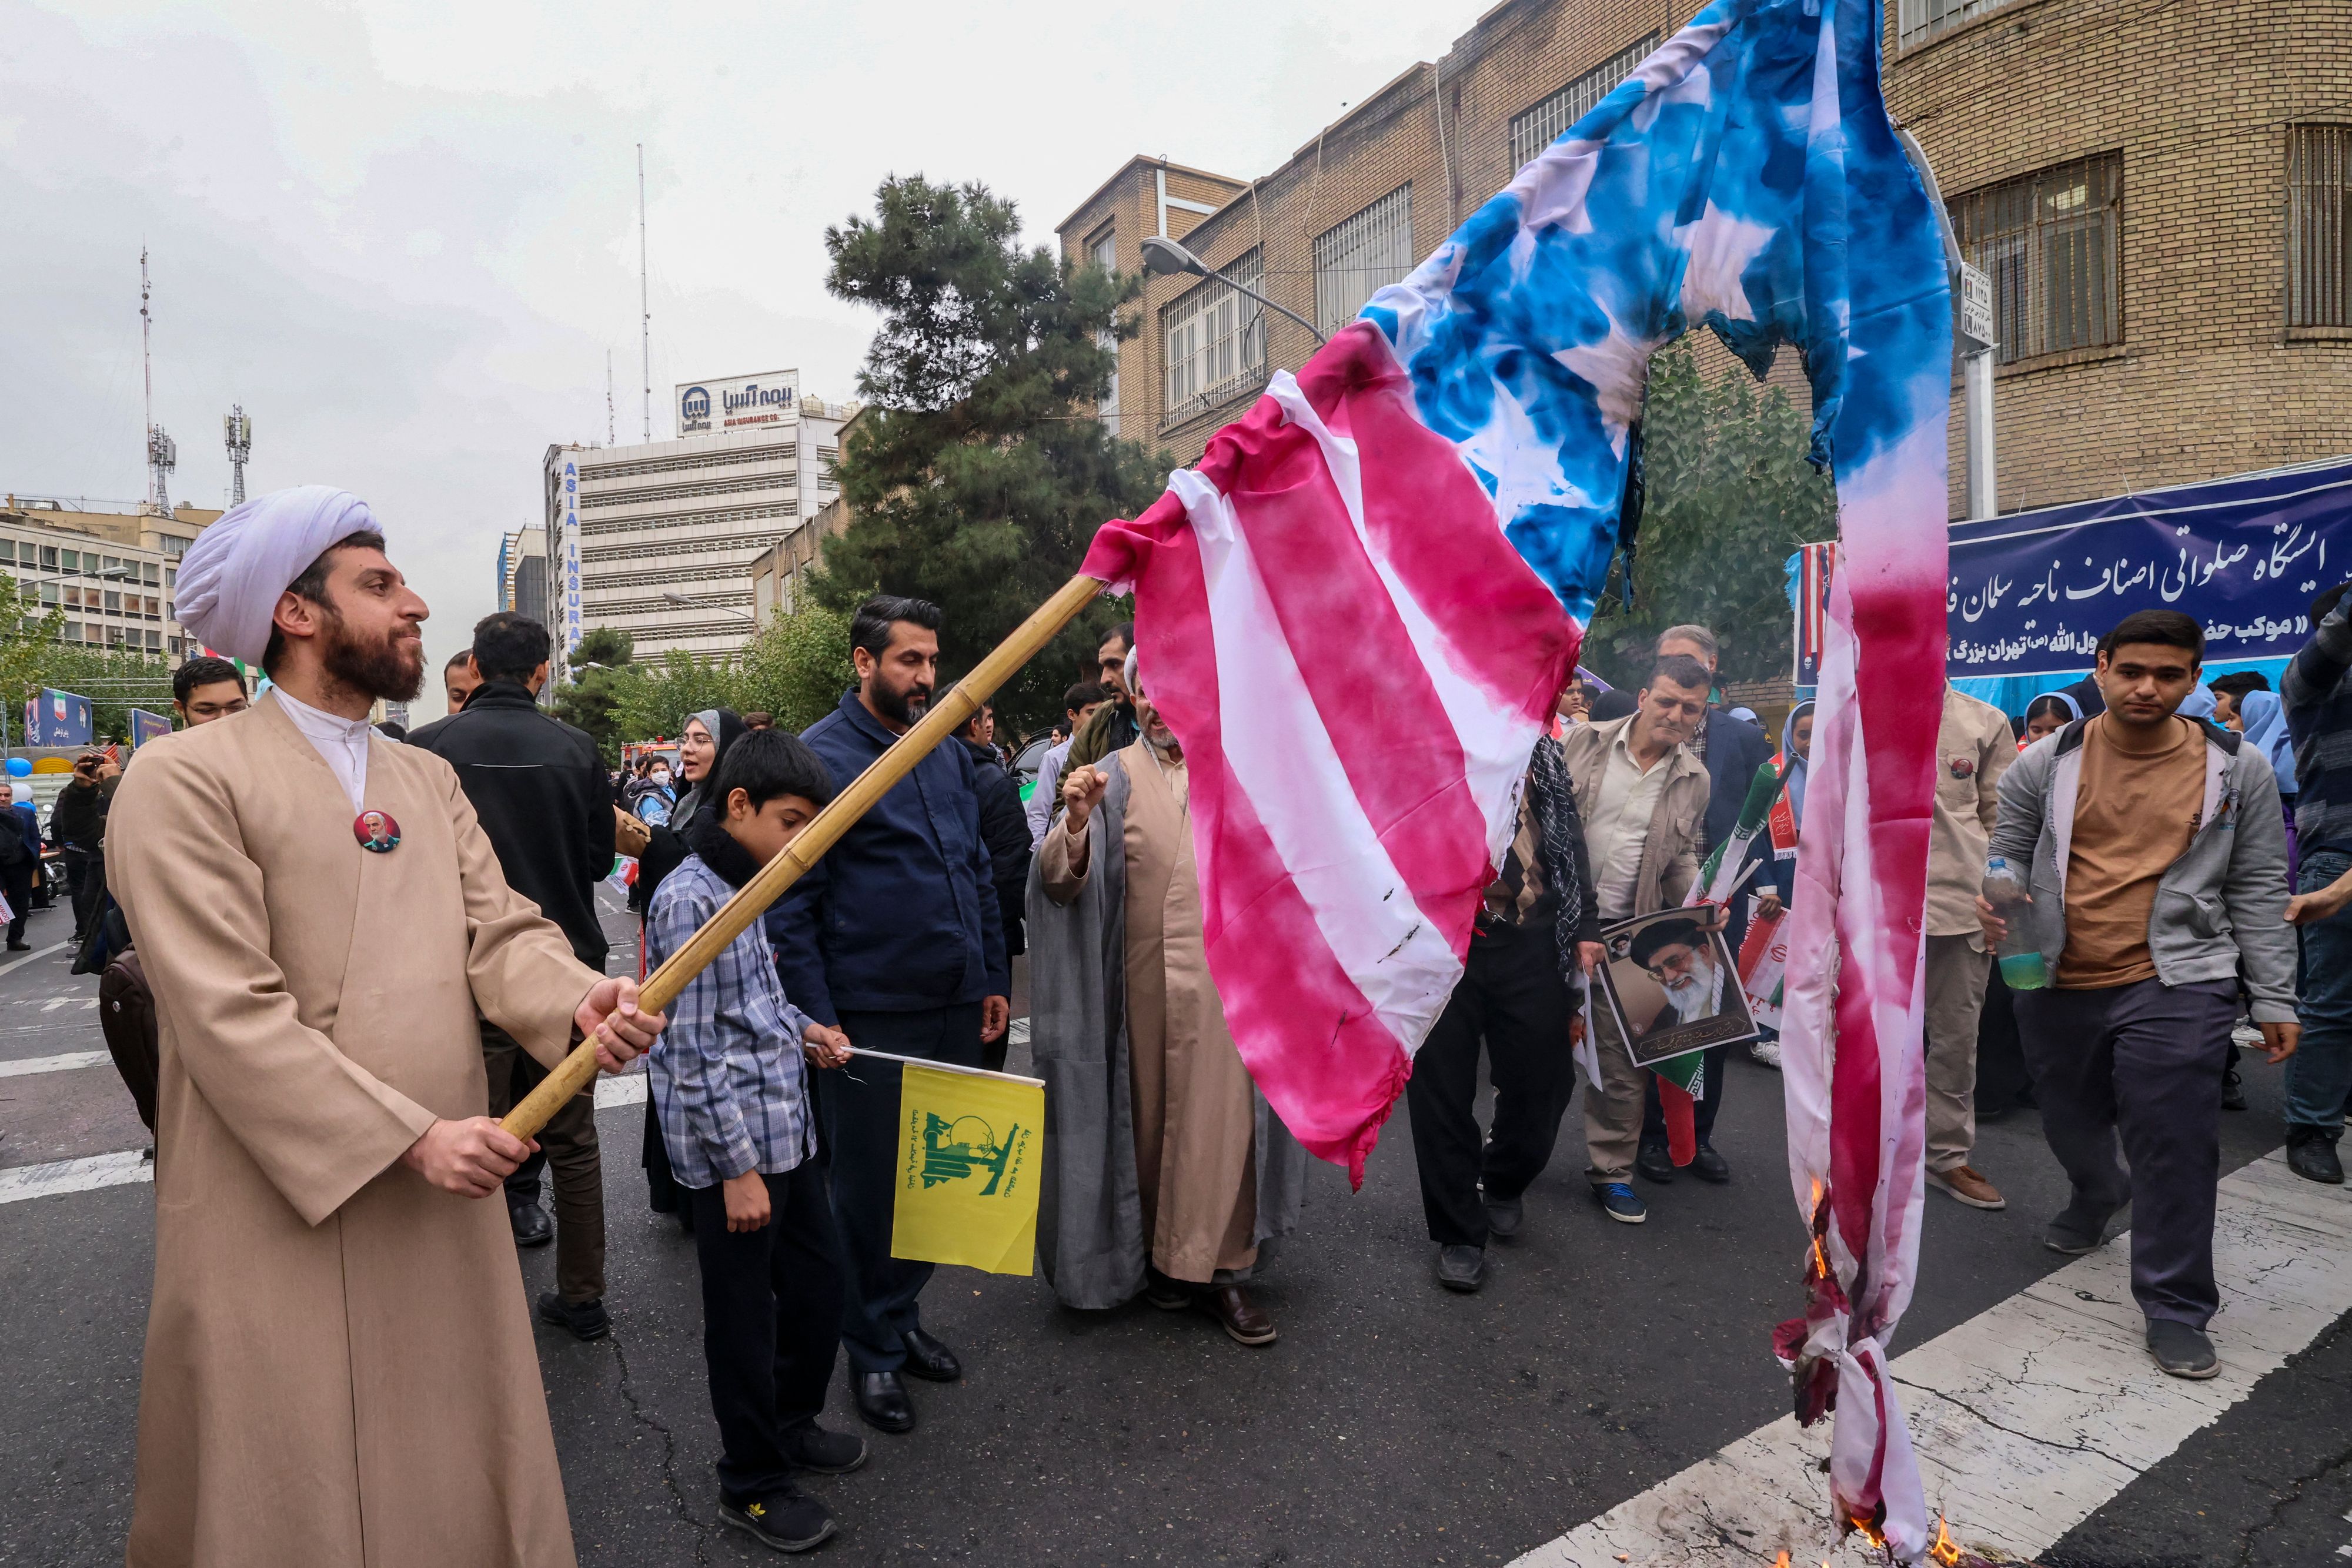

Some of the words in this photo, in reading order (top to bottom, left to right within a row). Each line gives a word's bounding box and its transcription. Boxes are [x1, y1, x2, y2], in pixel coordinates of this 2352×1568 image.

[723, 384, 759, 415] آسیا
[760, 387, 792, 409] بیمه
[724, 418, 736, 427] ASIA
[737, 414, 769, 426] INSURANCE
[564, 462, 578, 526] ASIA
[2066, 556, 2154, 600] اصناف
[2160, 524, 2249, 603] صلواتی
[2253, 522, 2325, 593] ایستگاه
[1962, 574, 2013, 623] سلمان
[2017, 559, 2061, 630] ناحیه
[1953, 638, 1987, 664] بزرگ
[1987, 636, 2027, 662] تهران
